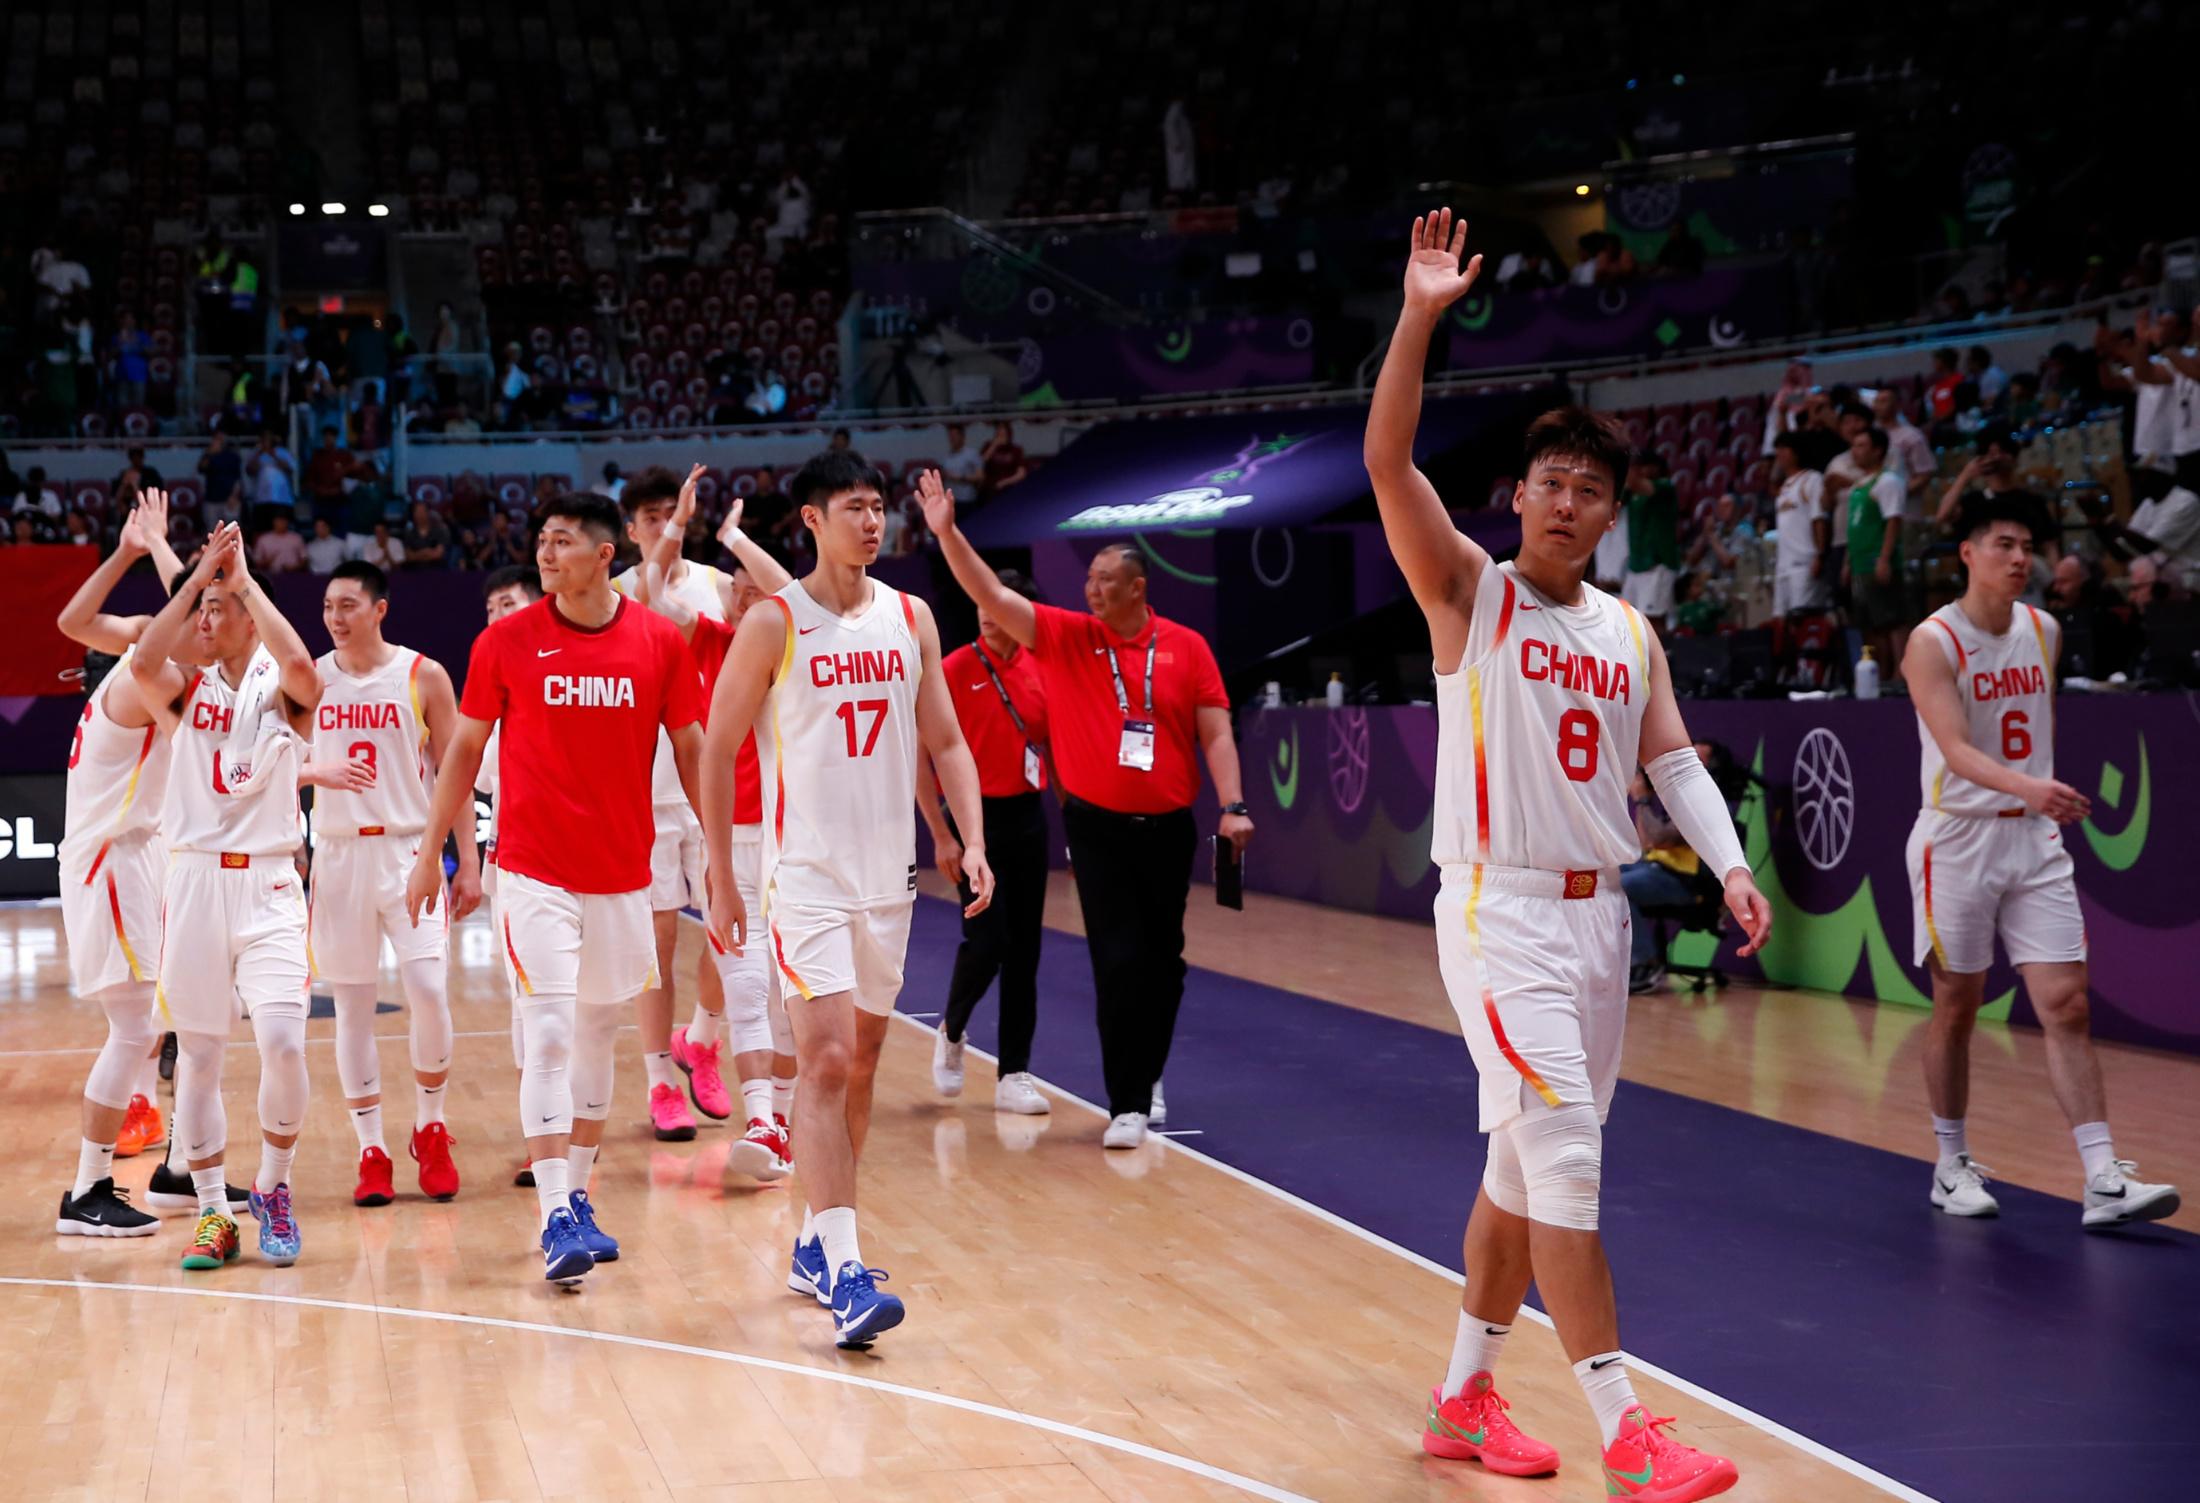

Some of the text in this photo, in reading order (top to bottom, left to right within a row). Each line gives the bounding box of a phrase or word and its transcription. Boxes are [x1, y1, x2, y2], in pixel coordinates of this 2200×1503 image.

[809, 649, 906, 688] CHINA
[1520, 638, 1631, 705] CHINA
[1972, 665, 2046, 702] CHINA
[543, 675, 635, 708] CHINA
[319, 703, 400, 731] CHINA
[835, 698, 889, 758] 17
[2001, 710, 2033, 760] 6
[1557, 708, 1600, 783] 8
